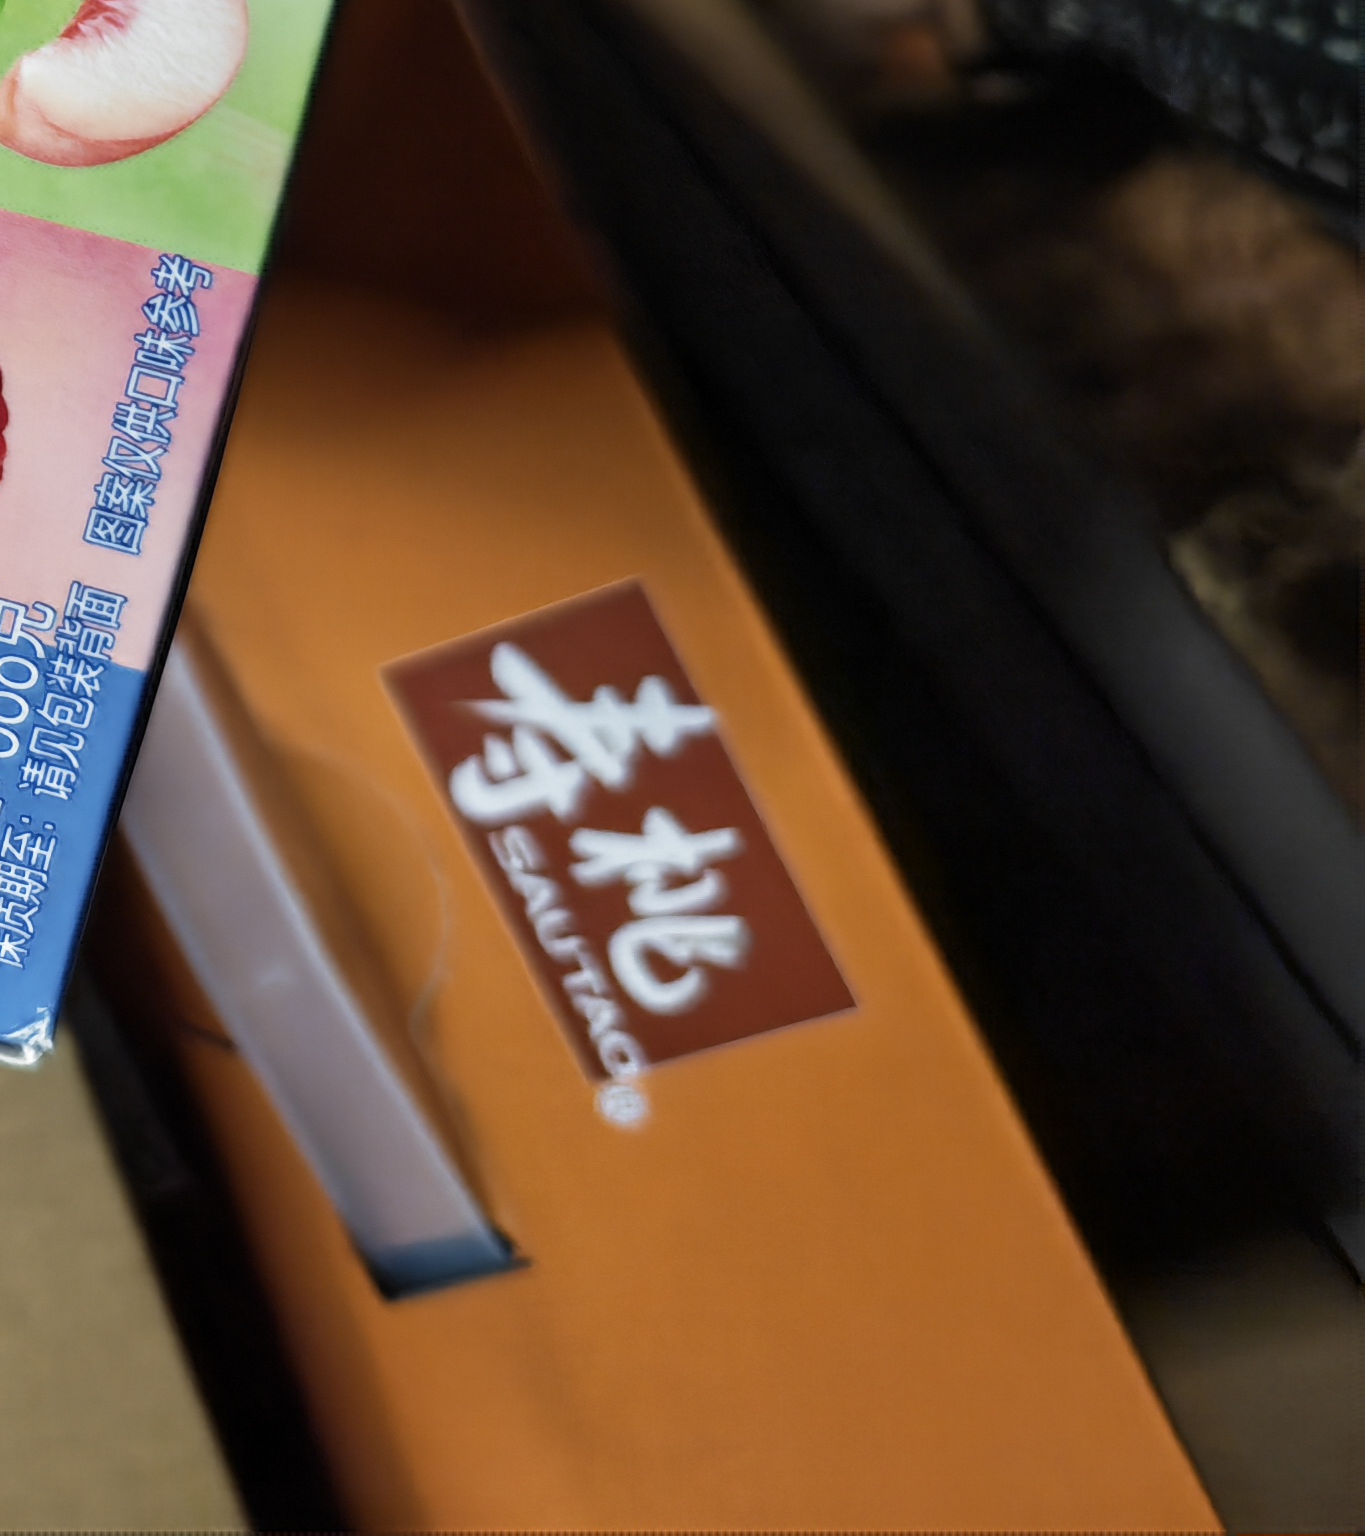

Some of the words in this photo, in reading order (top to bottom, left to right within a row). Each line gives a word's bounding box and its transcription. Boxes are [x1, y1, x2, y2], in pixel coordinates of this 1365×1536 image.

[83, 253, 215, 557] 图案仅供口味参考
[447, 640, 753, 1016] 寿桃
